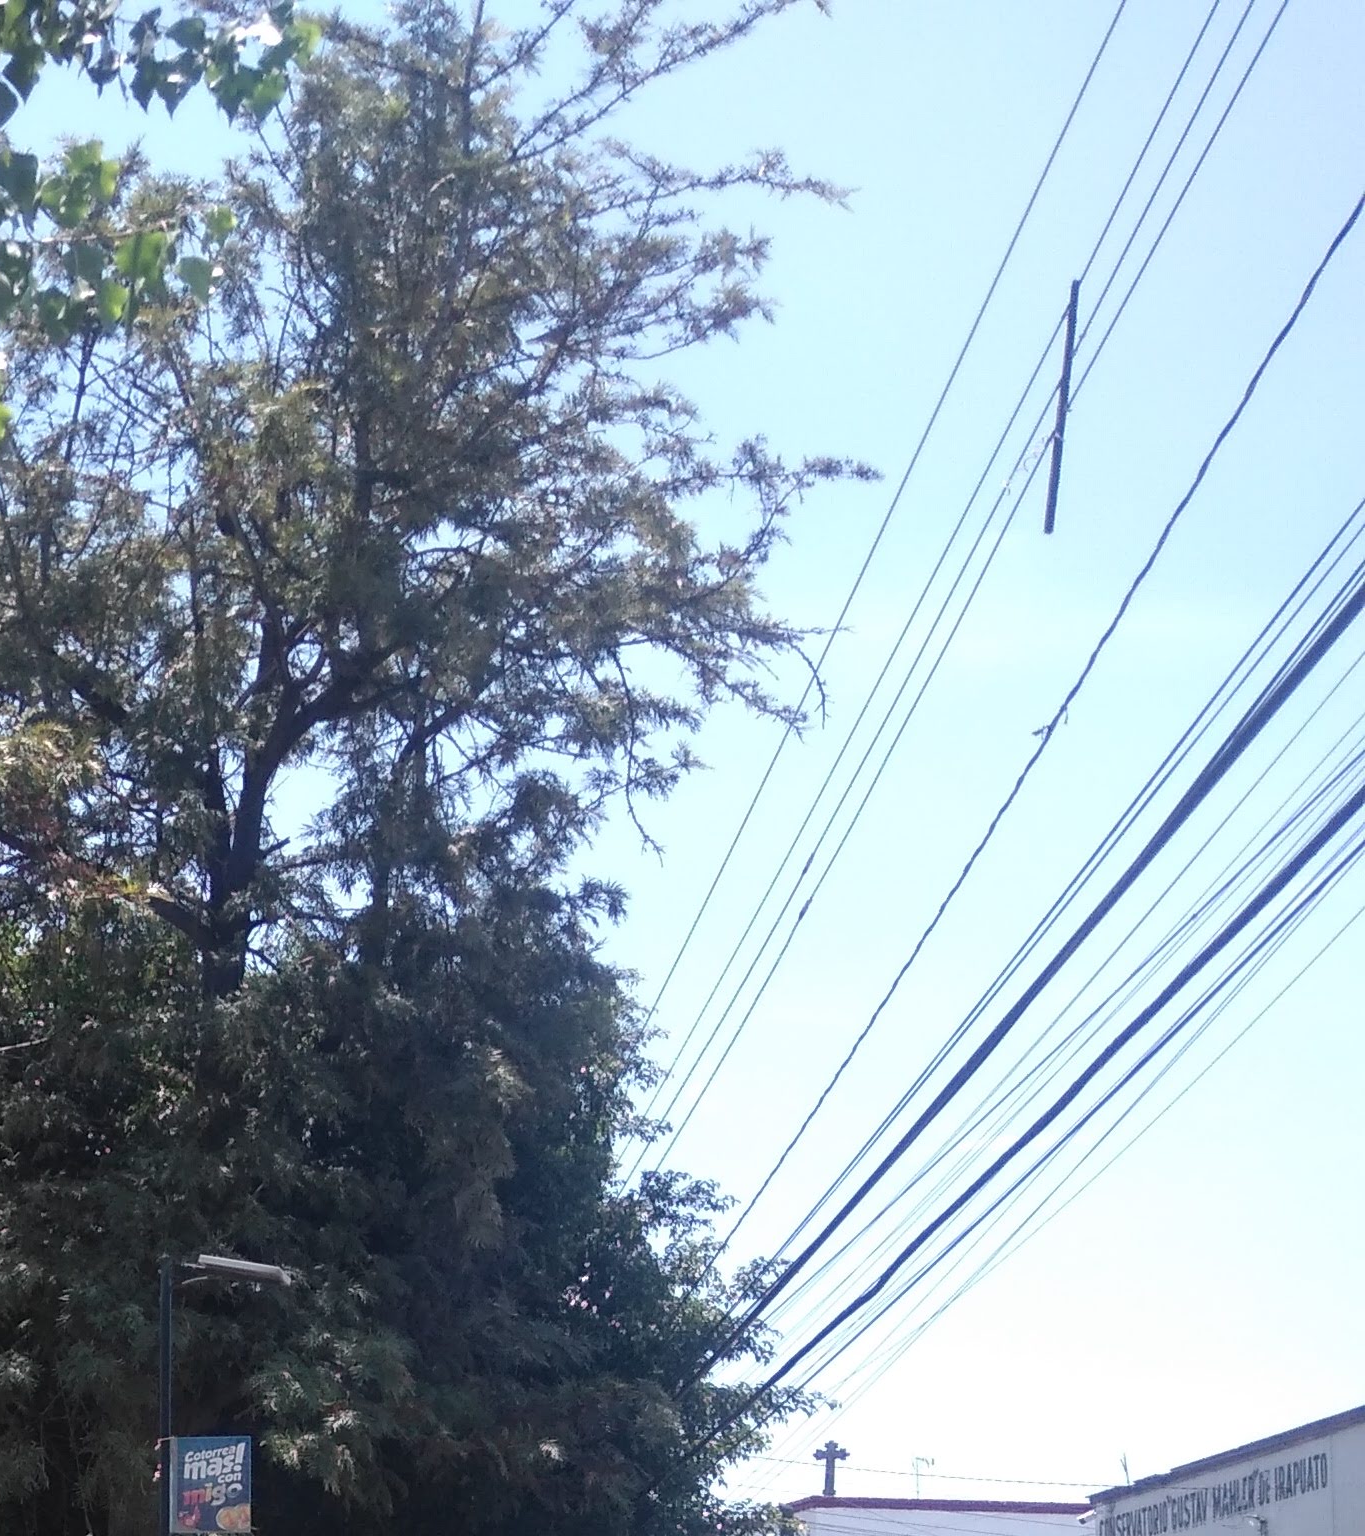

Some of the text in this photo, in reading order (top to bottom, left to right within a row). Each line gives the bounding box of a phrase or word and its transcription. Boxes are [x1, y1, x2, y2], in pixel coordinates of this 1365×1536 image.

[217, 1472, 242, 1484] con
[1258, 1470, 1270, 1506] DE
[1274, 1453, 1328, 1502] IRAPUATO
